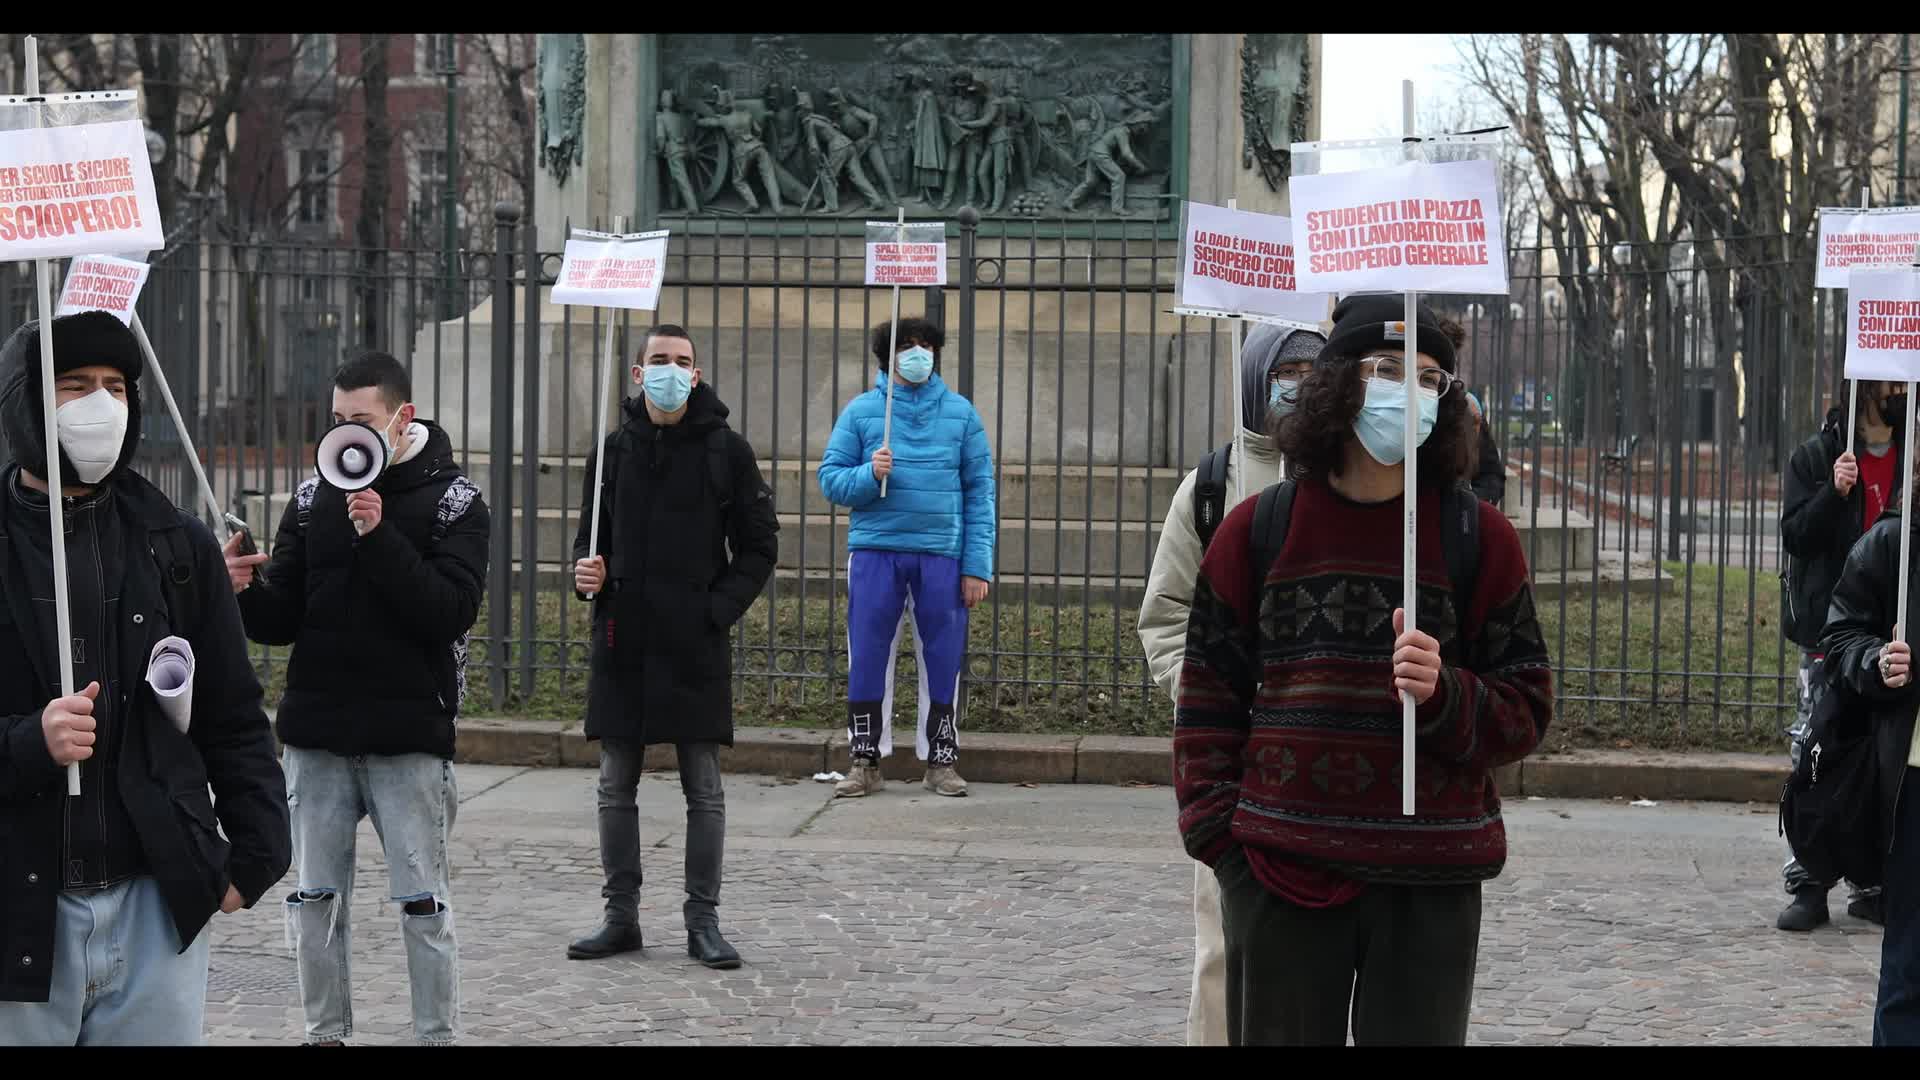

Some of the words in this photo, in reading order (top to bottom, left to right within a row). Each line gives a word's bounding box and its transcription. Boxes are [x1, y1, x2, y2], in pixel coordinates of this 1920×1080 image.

[0, 167, 20, 187] ER
[22, 163, 75, 185] SCUOLE
[0, 188, 13, 203] ER
[15, 185, 62, 202] STUDENTI
[63, 184, 70, 197] E
[70, 177, 134, 197] LAVORATORI
[0, 195, 142, 241] SCIOPERO!
[1307, 202, 1397, 231] STUDENTI
[1401, 199, 1420, 220] IN
[1424, 198, 1483, 221] PIAZZA
[1194, 230, 1207, 244] LA
[1208, 232, 1231, 249] DAD
[1241, 239, 1256, 253] UN
[1258, 242, 1295, 257] FALLIM
[1308, 229, 1347, 252] CON
[1350, 229, 1356, 247] I
[1360, 221, 1464, 246] LAVORATORI
[1467, 221, 1485, 242] IN
[1194, 244, 1261, 272] SCIOPERO
[1263, 257, 1296, 276] CON
[1309, 245, 1401, 274] SCIOPERO
[1405, 244, 1488, 266] GENERALE
[1825, 244, 1875, 256] SCIOPERO
[1825, 257, 1836, 267] LA
[875, 265, 938, 276] SCIOPERIAMO
[1193, 261, 1208, 276] LA
[1209, 263, 1255, 287] SCUOLA
[1256, 273, 1271, 288] DI
[1272, 275, 1297, 291] CLA
[93, 277, 136, 297] CONTRO
[96, 294, 129, 312] CLASSE
[1858, 316, 1886, 331] CON
[1888, 317, 1893, 332] I
[1857, 333, 1920, 350] SCIOPERO
